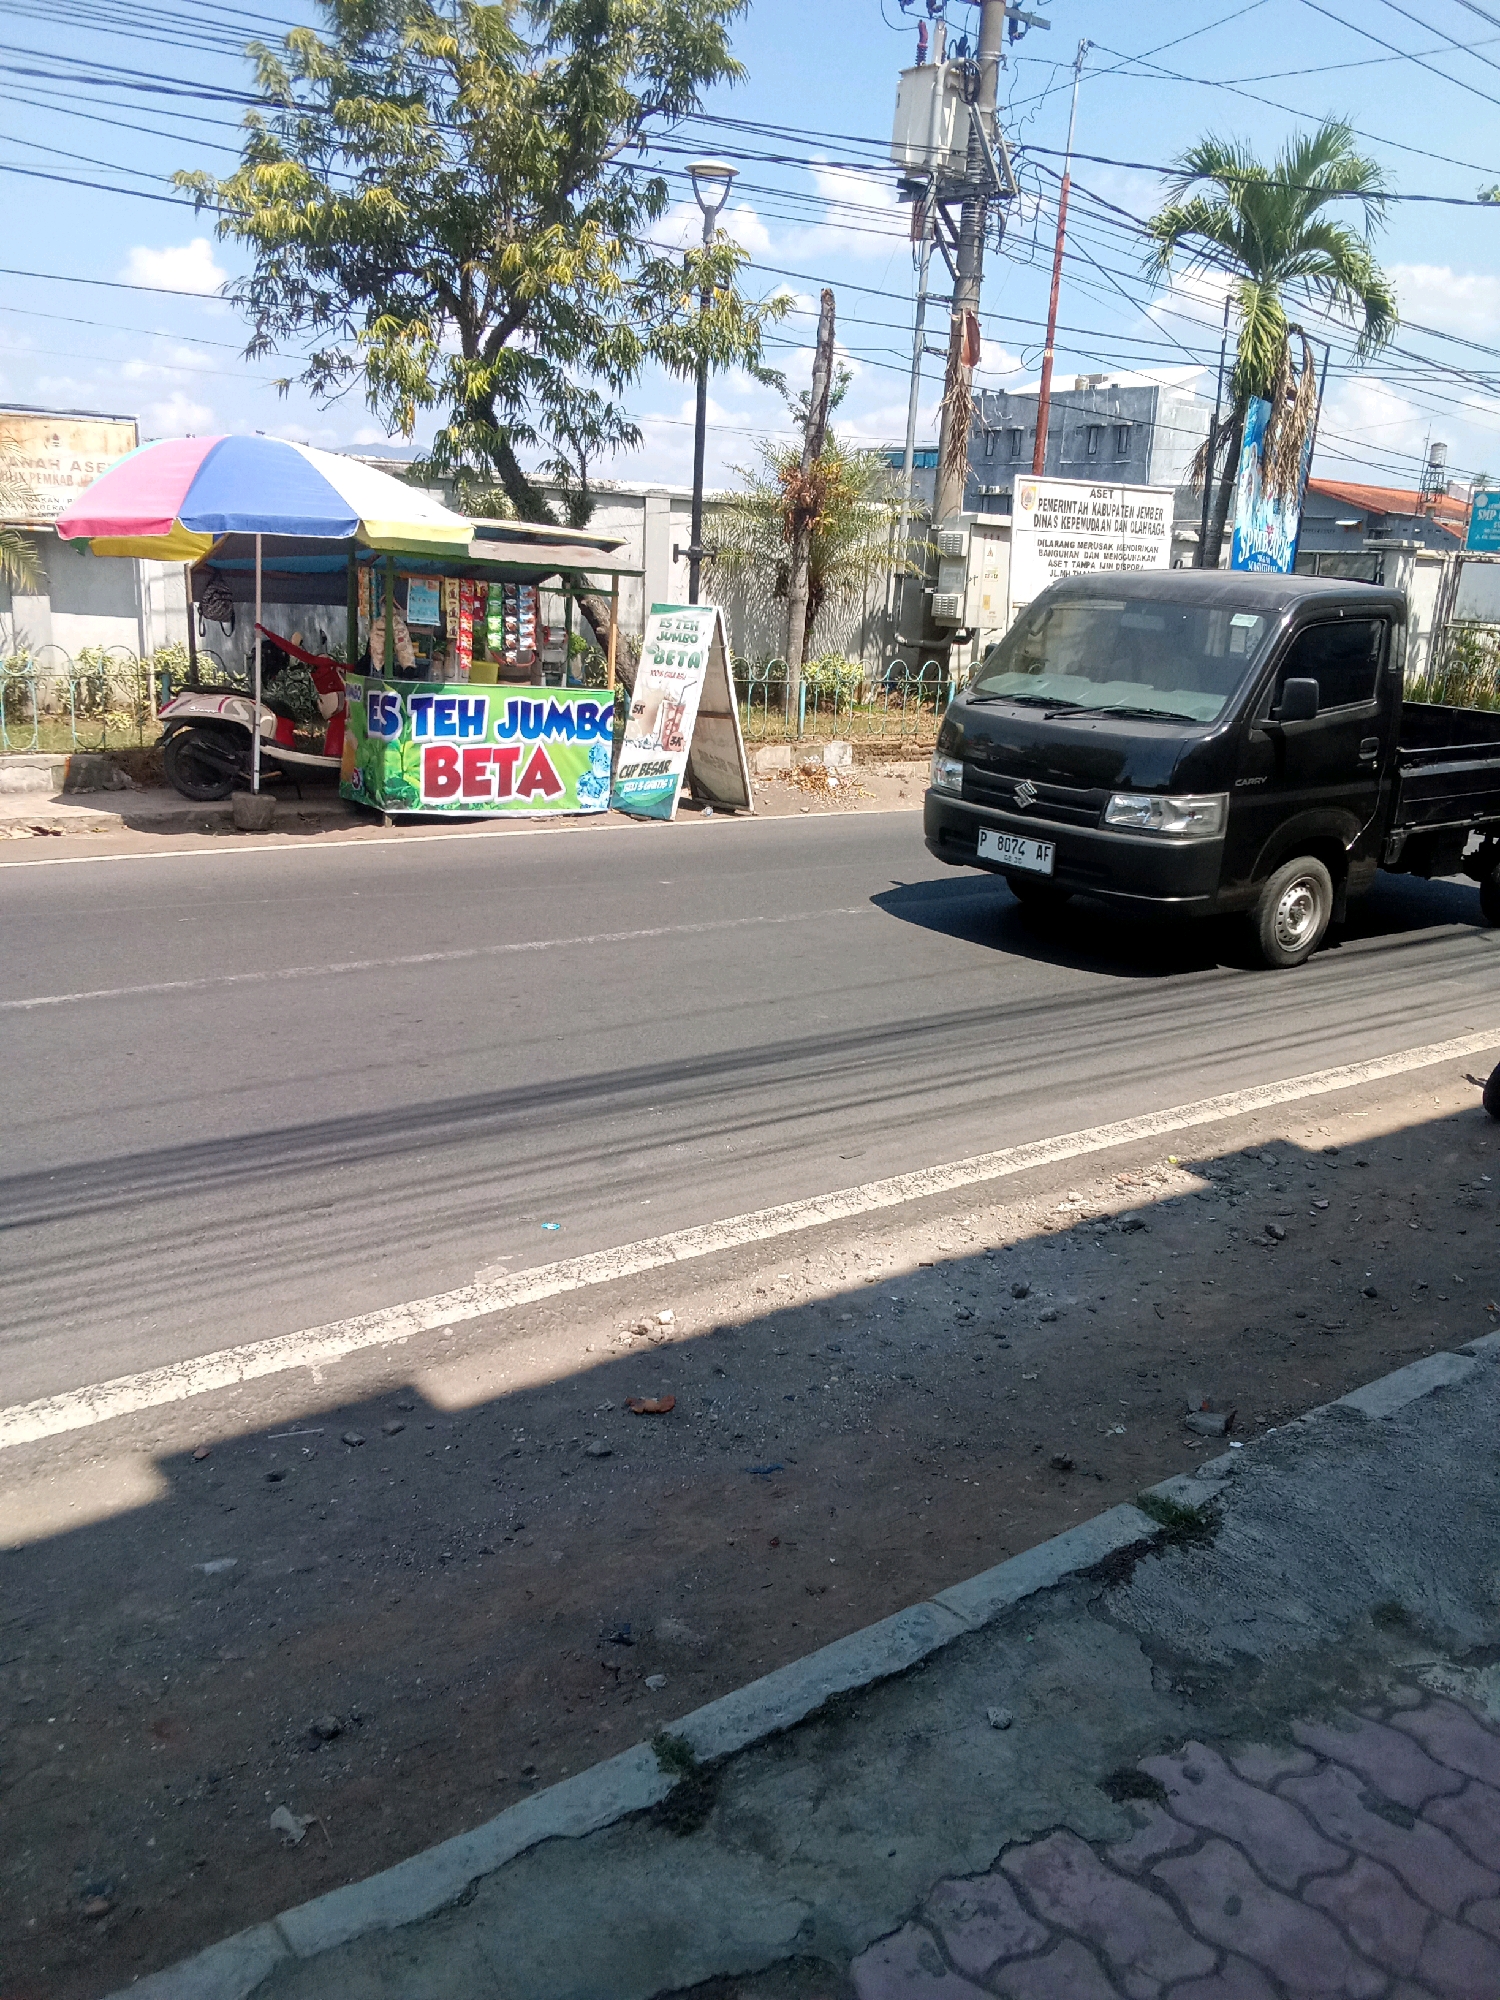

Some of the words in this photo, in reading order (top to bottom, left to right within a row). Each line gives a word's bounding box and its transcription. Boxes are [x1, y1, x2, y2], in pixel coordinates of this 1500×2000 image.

[1089, 488, 1114, 499] ASET
[1037, 498, 1089, 515] PEMERINTAH
[1091, 502, 1135, 519] KABUPATEN
[1136, 506, 1164, 521] JEMBER
[1033, 513, 1059, 528] DINAS
[1060, 515, 1112, 532] KEPEMUDAAN
[1114, 519, 1128, 533] DAN
[1130, 520, 1166, 537] OLAHRAGA
[1037, 539, 1075, 549] DILARANG
[1076, 541, 1114, 551] MERUSAK
[1038, 549, 1079, 559] BANGUNAN
[1084, 551, 1100, 560] DAN
[1048, 559, 1069, 568] ASET
[660, 618, 673, 628] ES
[656, 631, 699, 643] JUMBO
[653, 649, 701, 669] BETA
[367, 692, 401, 740] ES
[409, 694, 488, 740] TEH
[423, 744, 564, 799] BETA
[619, 764, 640, 779] CUP
[638, 759, 673, 777] BESAR
[1234, 776, 1268, 787] CARRY
[979, 831, 988, 847] P
[997, 835, 1026, 856] 8074
[1036, 844, 1052, 862] AF
